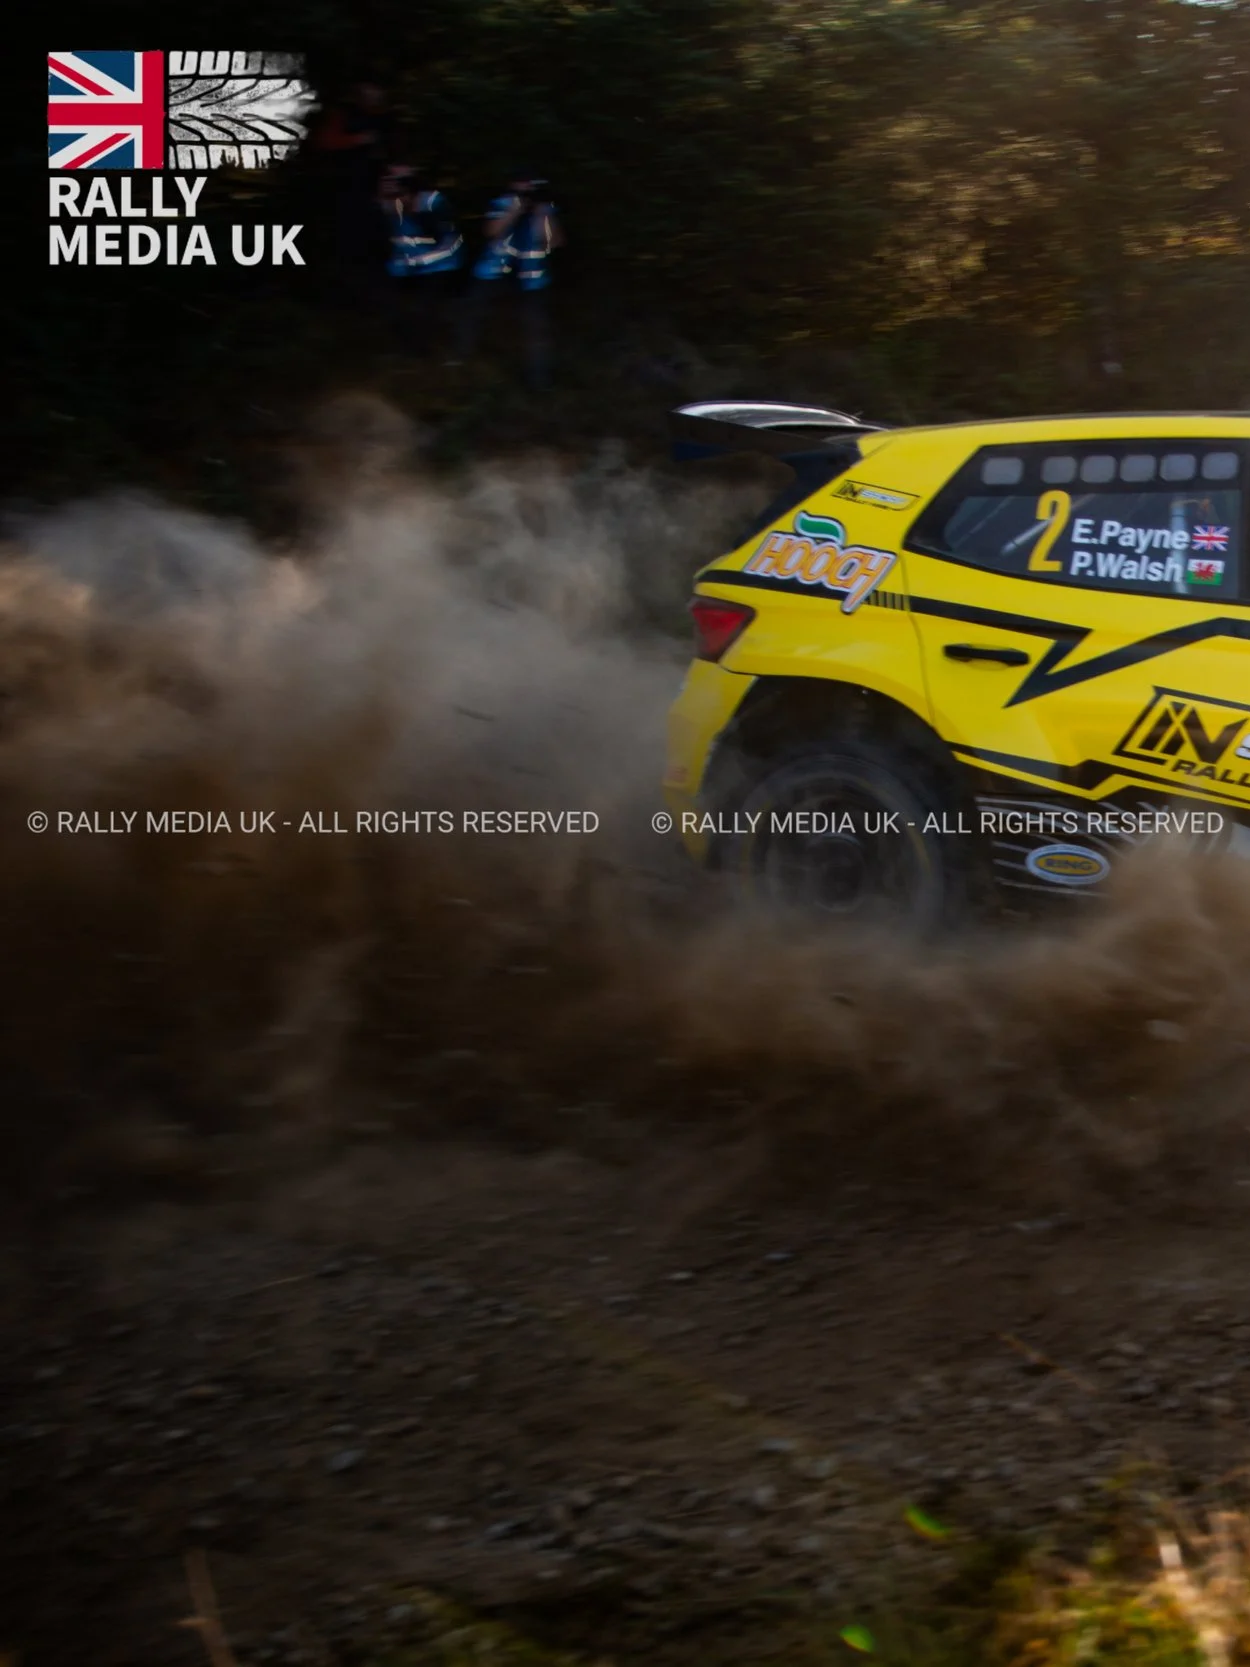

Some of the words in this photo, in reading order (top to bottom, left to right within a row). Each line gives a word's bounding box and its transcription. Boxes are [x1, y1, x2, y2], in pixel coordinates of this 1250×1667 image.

[1028, 489, 1072, 572] 2
[1071, 518, 1191, 554] E.Payne
[1069, 550, 1184, 583] P.Walsh
